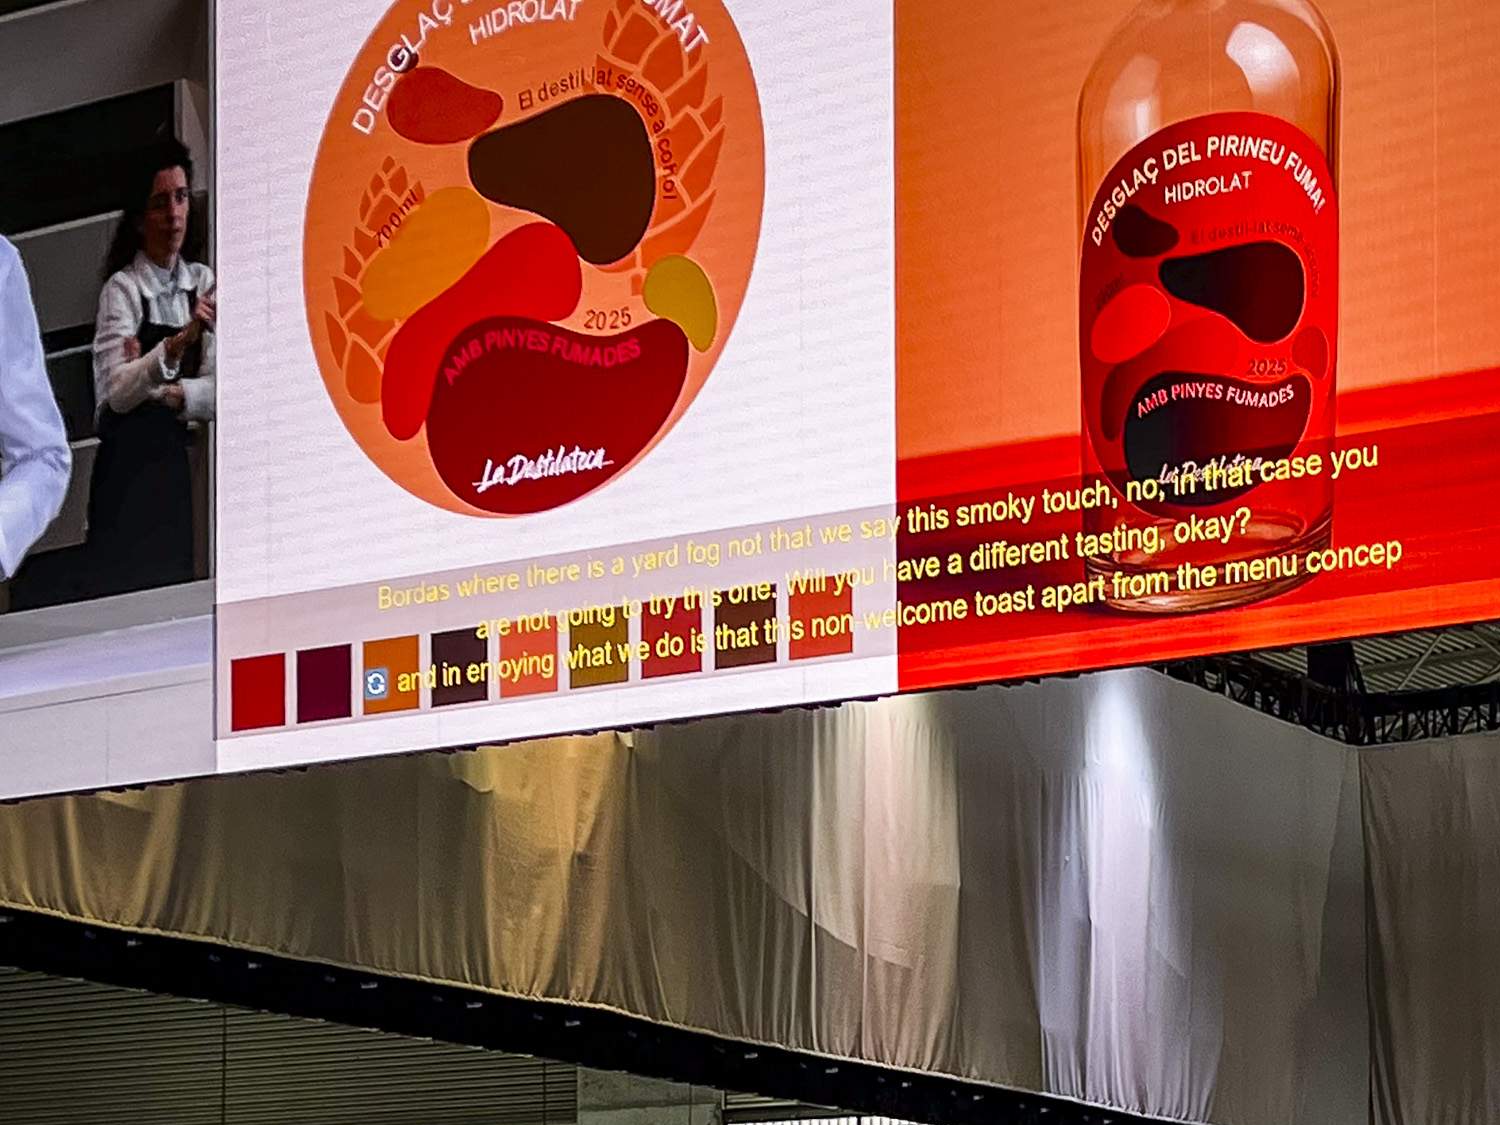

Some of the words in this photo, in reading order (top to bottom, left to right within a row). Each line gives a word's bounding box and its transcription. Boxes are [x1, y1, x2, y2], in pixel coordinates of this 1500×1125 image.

[469, 0, 581, 45] HIDROLAT
[643, 0, 710, 52] MAT
[1091, 157, 1159, 247] DESGLAÇ
[1162, 140, 1202, 172] DEL
[1206, 134, 1286, 167] PIRINEU
[1163, 170, 1253, 205] HIDROLAT
[584, 306, 631, 330] 2025
[444, 339, 483, 386] AMB
[484, 328, 550, 352] PINYES
[551, 337, 641, 368] FUMADES
[1247, 358, 1287, 376] 2025
[1171, 382, 1223, 400] PINYES
[1226, 384, 1295, 409] FUMADES
[378, 581, 450, 610] Bordas
[456, 571, 520, 598] where
[527, 561, 580, 588] there
[587, 555, 604, 578] is
[611, 556, 625, 575] a
[632, 544, 679, 578] yard
[686, 540, 721, 567] fog
[728, 534, 763, 559] not
[769, 524, 813, 553] that
[819, 523, 851, 544] we
[860, 515, 901, 541] say
[907, 504, 949, 534] this
[956, 492, 1035, 524] smoky
[1041, 480, 1118, 514] touch,
[1126, 477, 1165, 502] no,
[1174, 470, 1195, 495] in
[1204, 459, 1253, 491] that
[1260, 453, 1322, 483] case
[1330, 445, 1378, 479] you
[475, 619, 512, 641] are
[516, 608, 551, 634] not
[556, 600, 615, 632] going
[622, 595, 642, 618] to
[649, 592, 675, 619] try
[728, 580, 778, 605] one.
[785, 567, 826, 597] Will
[833, 565, 875, 597] you
[883, 554, 940, 583] have
[947, 553, 963, 575] a
[969, 533, 1069, 572] different
[1075, 523, 1166, 556] tasting,
[1174, 507, 1252, 544] okay?
[397, 664, 437, 693] and
[442, 662, 461, 687] in
[466, 651, 554, 685] enoying
[562, 640, 612, 672] what
[617, 641, 650, 663] we
[655, 632, 684, 658] do
[690, 628, 707, 654] is
[715, 622, 759, 651] that
[763, 617, 804, 644] this
[974, 584, 1035, 617] toast
[1041, 575, 1106, 613] apart
[1111, 568, 1169, 600] from
[1177, 562, 1217, 590] the
[1224, 553, 1298, 584] menu
[1305, 539, 1402, 574] concep
